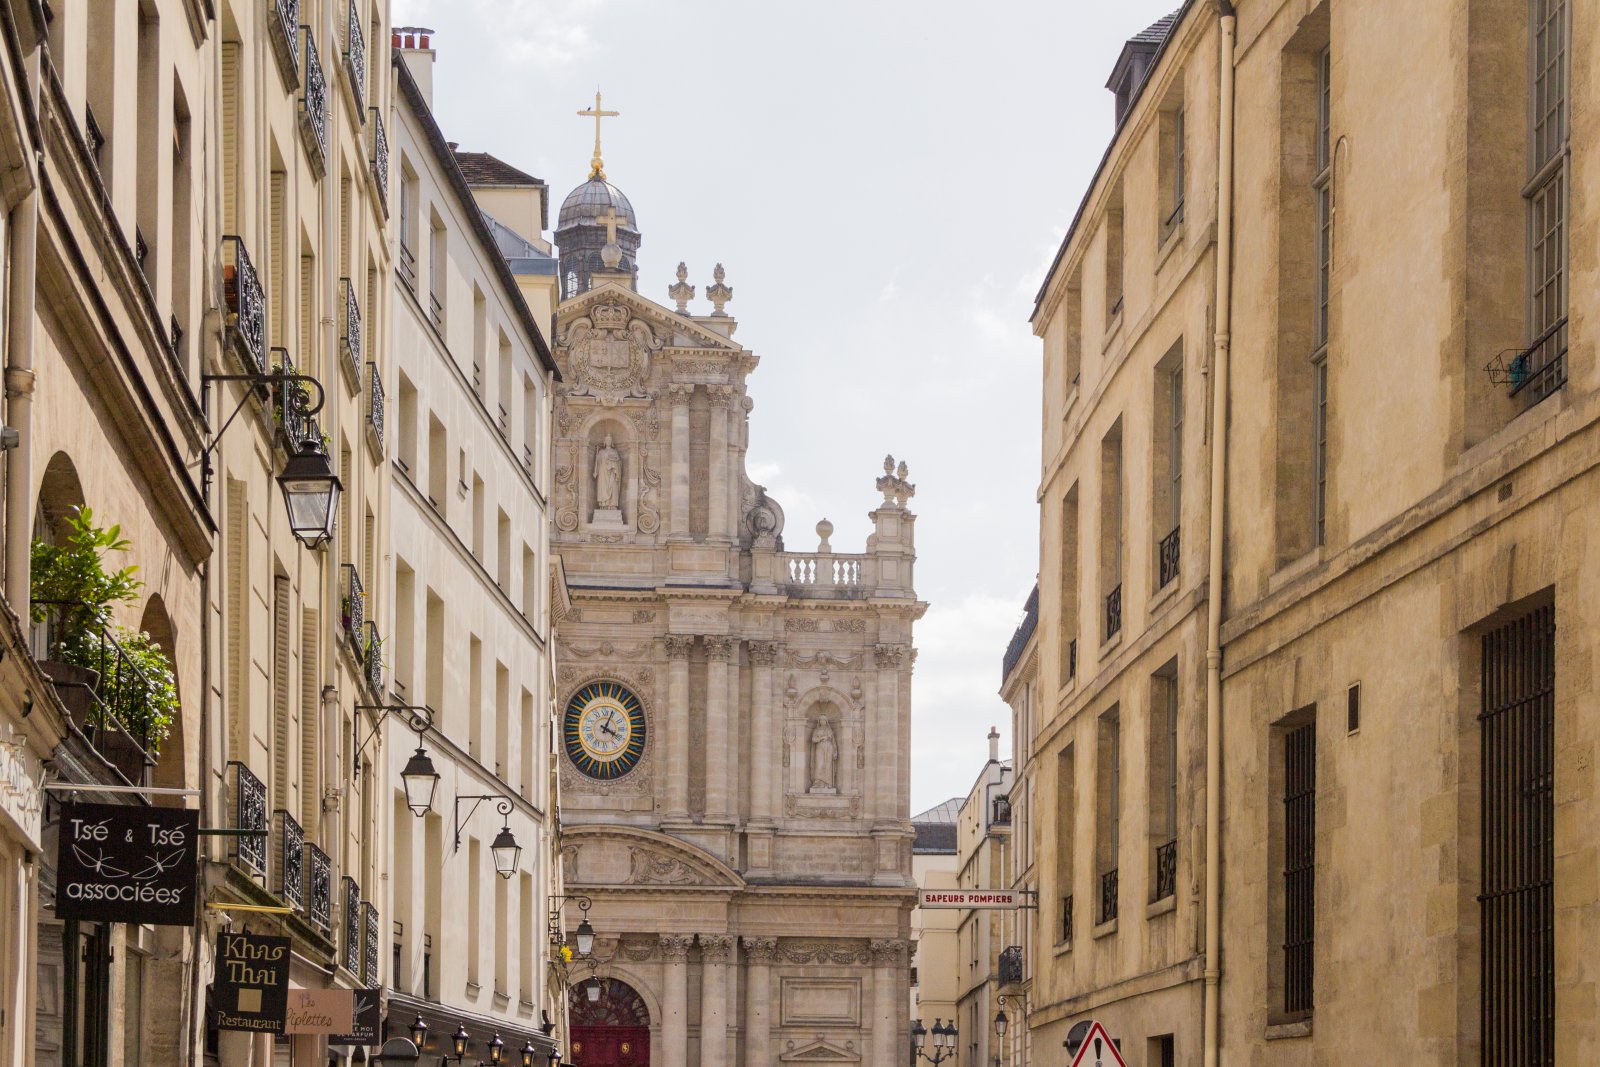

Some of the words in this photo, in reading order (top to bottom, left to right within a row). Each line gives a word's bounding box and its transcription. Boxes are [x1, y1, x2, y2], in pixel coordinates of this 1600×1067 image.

[71, 818, 113, 842] Tsé
[125, 829, 133, 842] &
[147, 823, 189, 847] Tsé
[66, 880, 188, 905] associées
[925, 894, 965, 903] SAPEURS
[968, 894, 1013, 904] POMPIERS
[223, 936, 287, 960] Khao
[226, 960, 278, 985] Thaï
[217, 1010, 281, 1030] Restaurant
